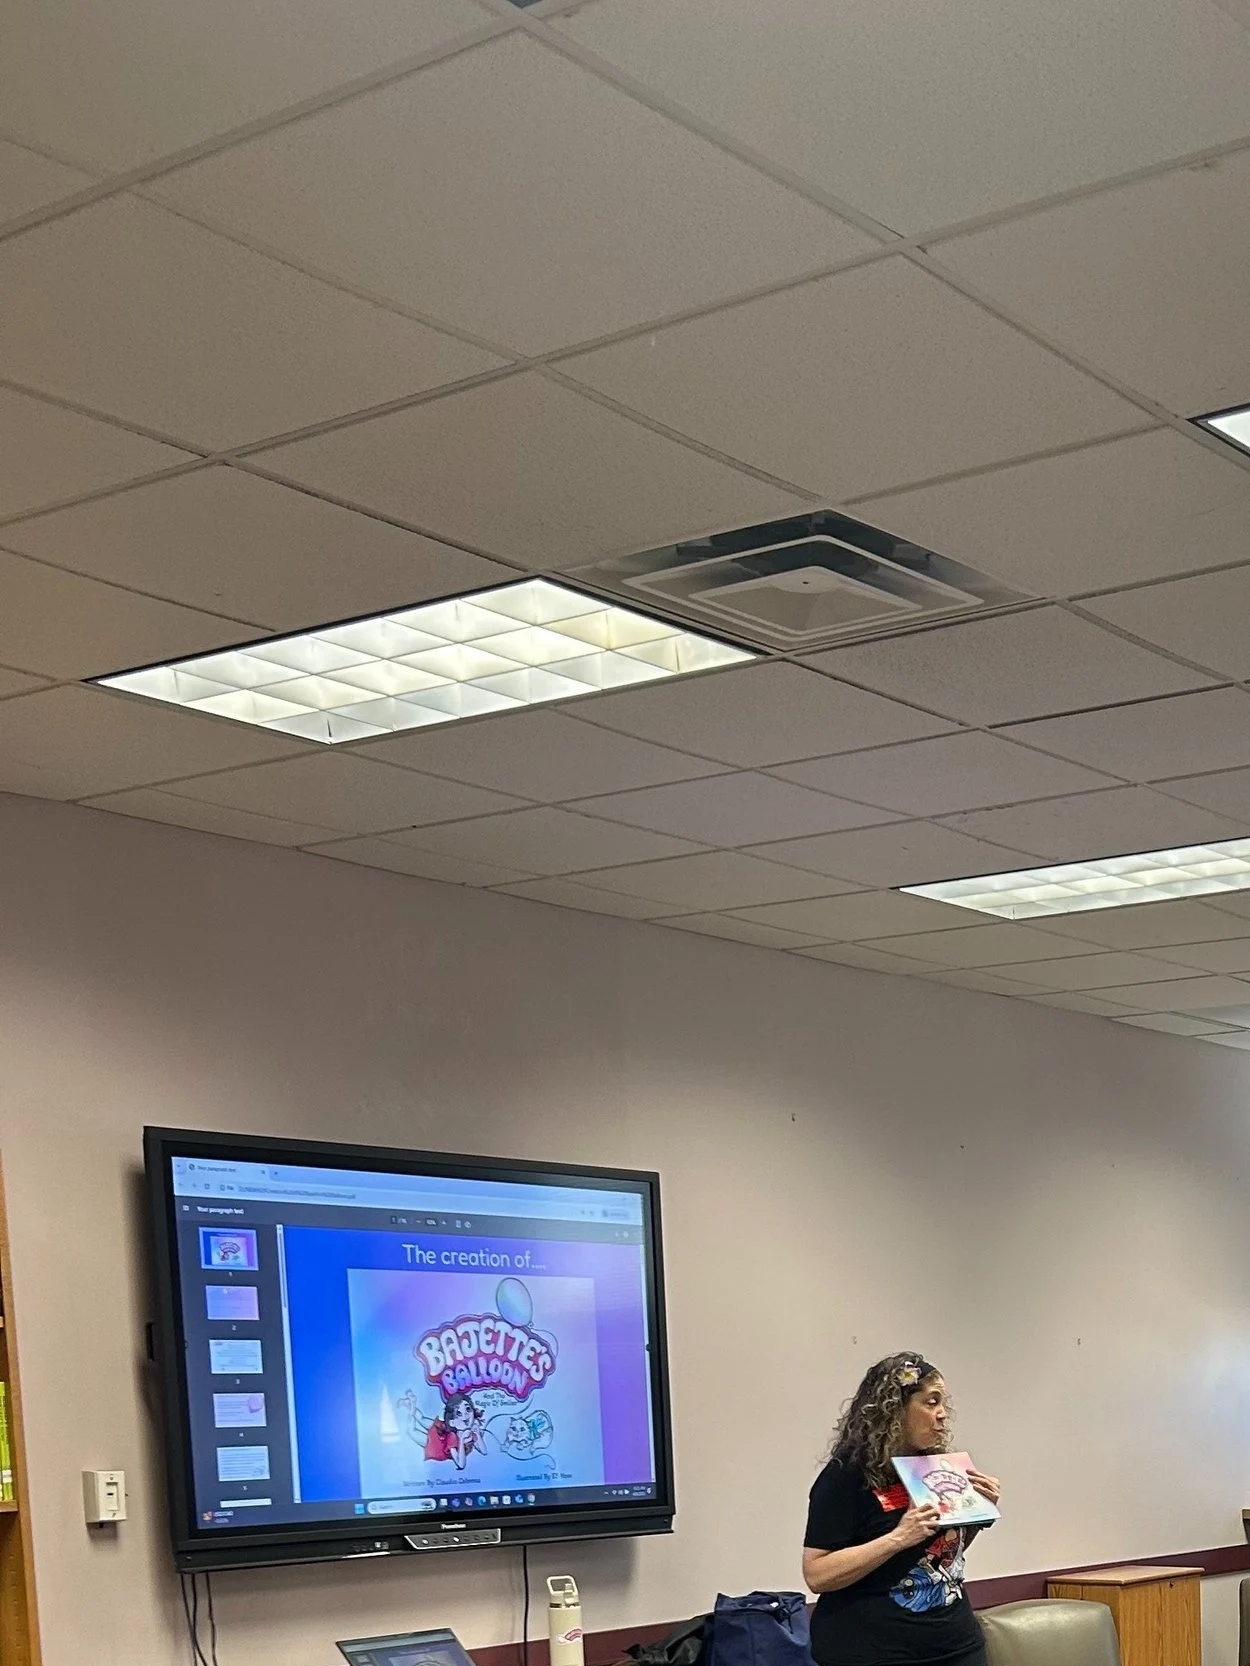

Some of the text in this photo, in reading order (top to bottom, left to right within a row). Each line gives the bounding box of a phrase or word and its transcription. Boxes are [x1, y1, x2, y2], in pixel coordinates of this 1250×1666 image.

[401, 1243, 437, 1264] The
[441, 1248, 510, 1267] creation
[419, 1318, 552, 1382] BAJETTE'S
[441, 1356, 528, 1395] BALLOON
